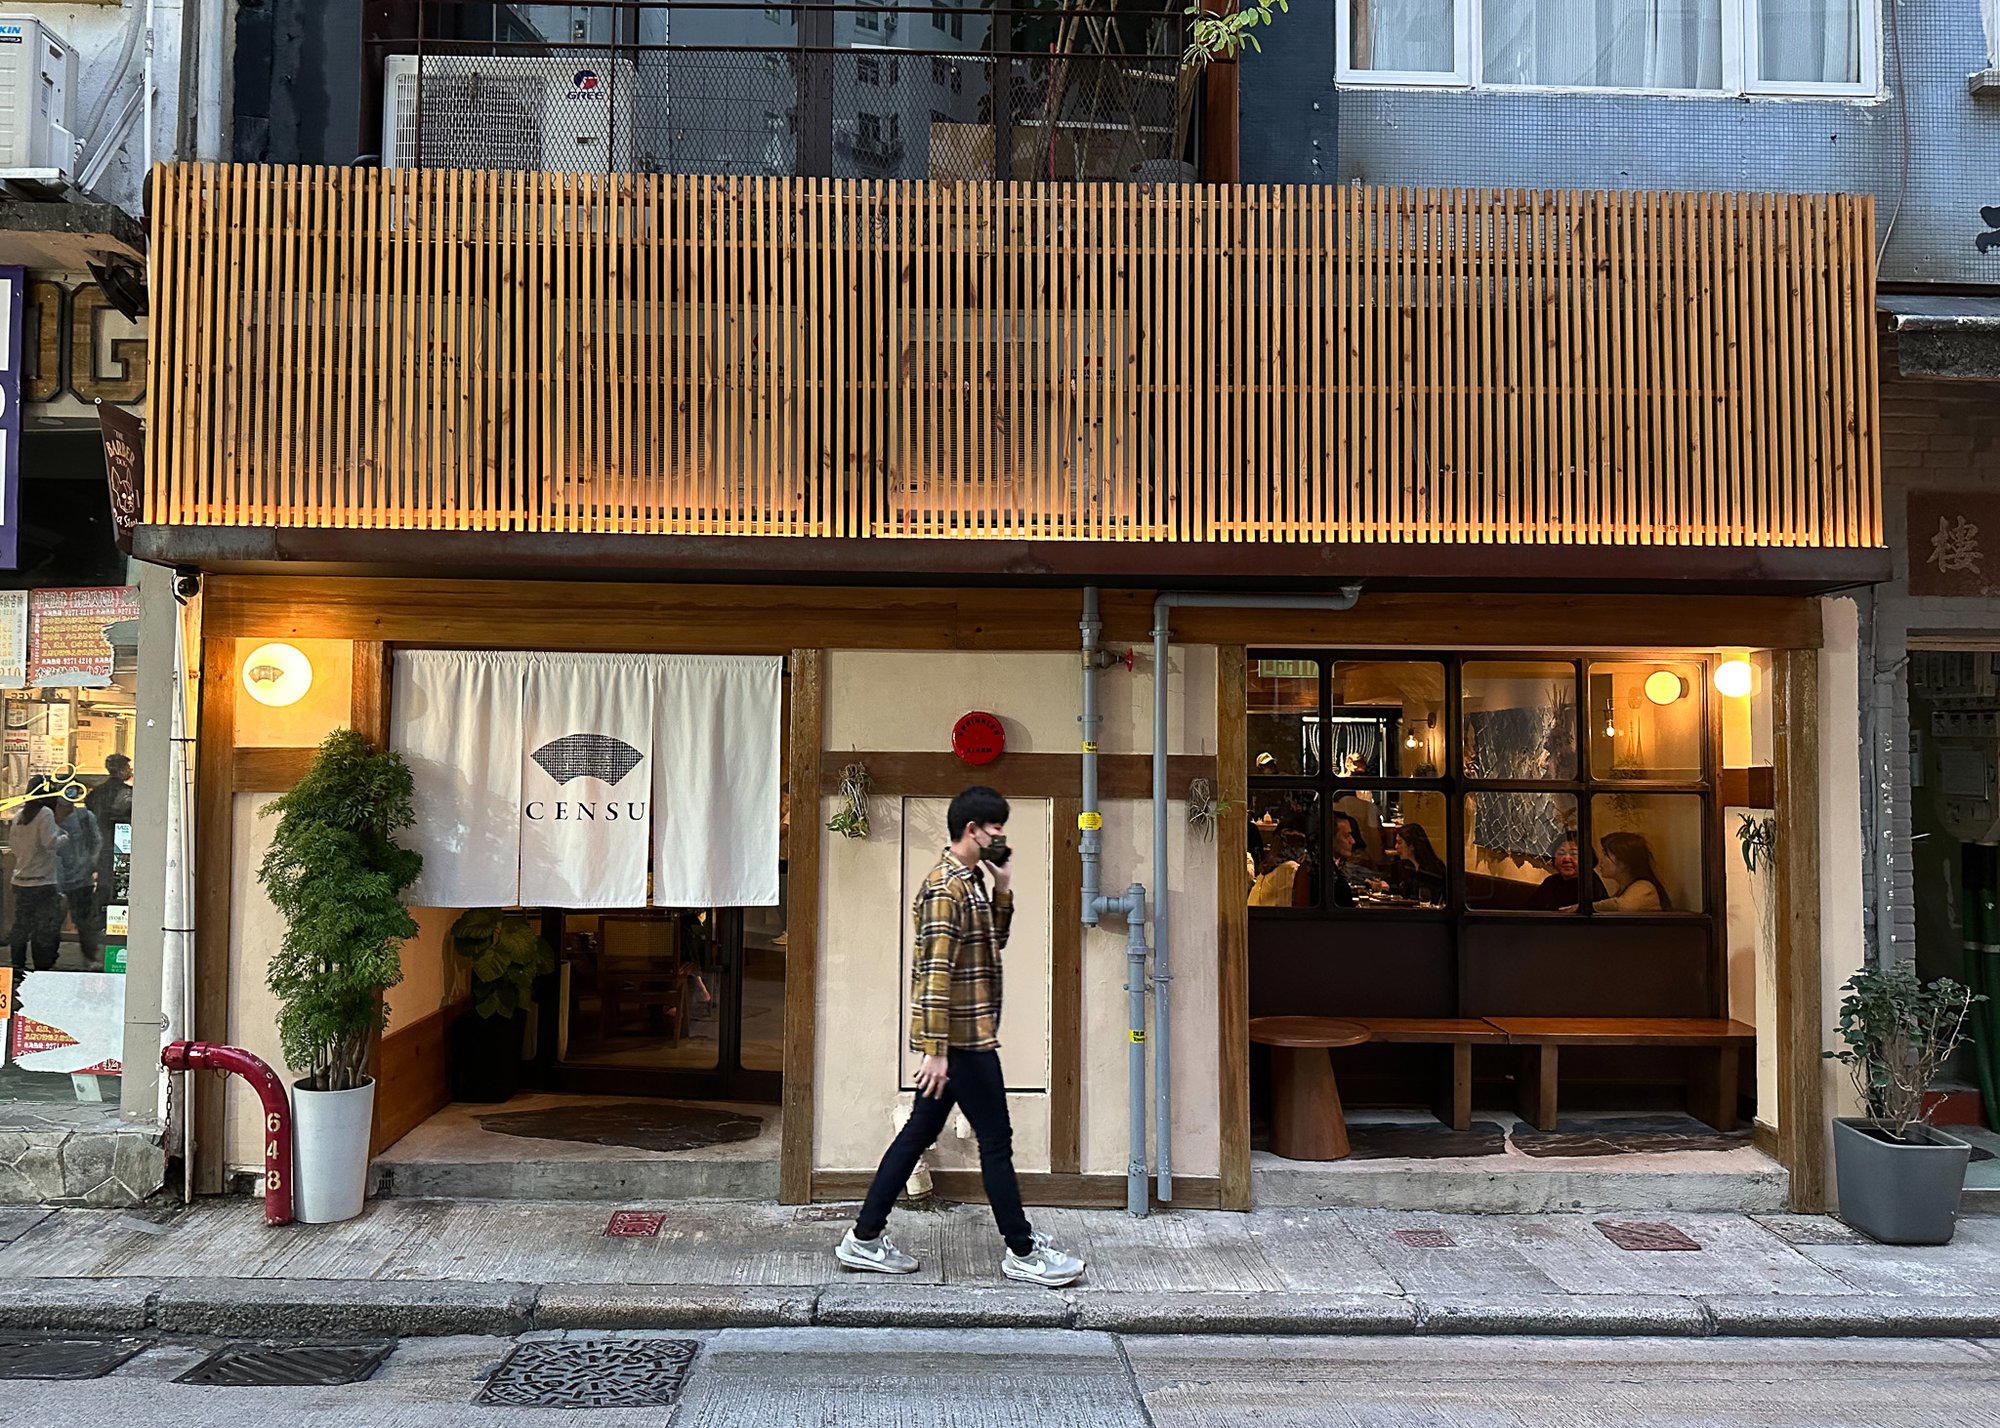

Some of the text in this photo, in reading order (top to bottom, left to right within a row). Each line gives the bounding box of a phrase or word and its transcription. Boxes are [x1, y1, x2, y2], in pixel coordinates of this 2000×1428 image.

[567, 91, 604, 100] GREE
[105, 440, 135, 467] BARBER
[1926, 515, 1984, 574] 樓
[525, 801, 647, 821] CENSU
[266, 1112, 282, 1190] 648
